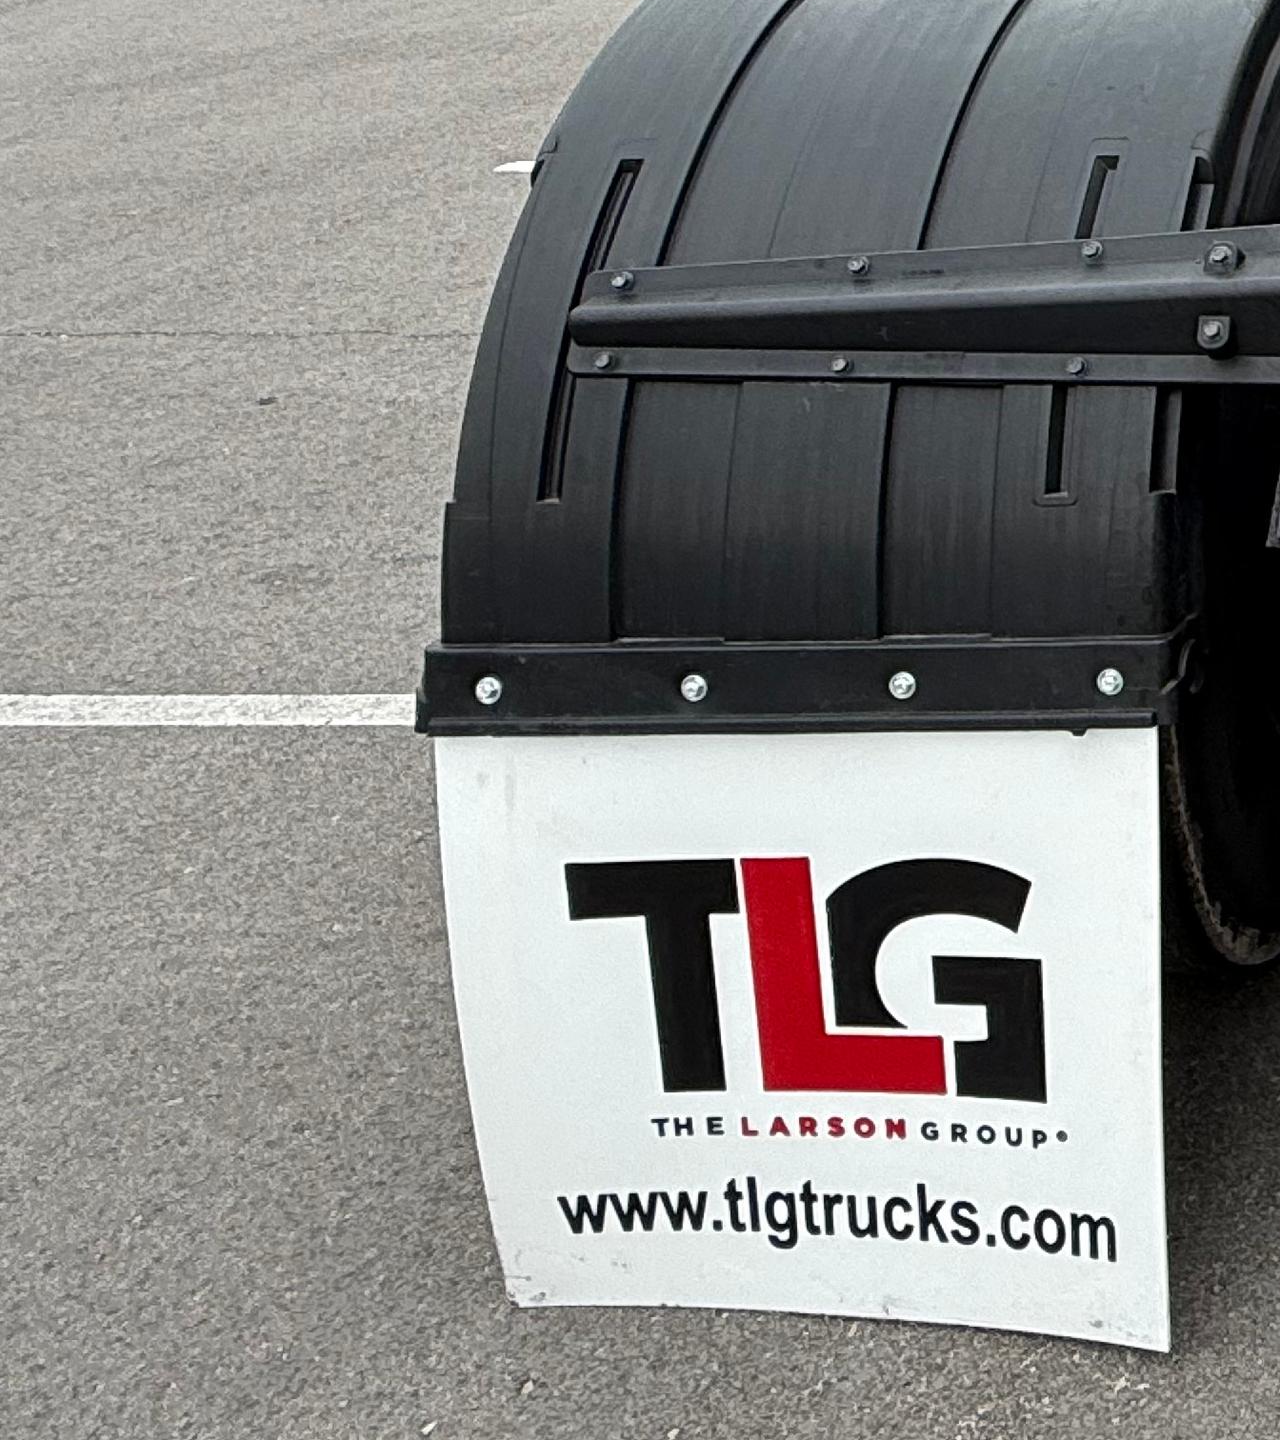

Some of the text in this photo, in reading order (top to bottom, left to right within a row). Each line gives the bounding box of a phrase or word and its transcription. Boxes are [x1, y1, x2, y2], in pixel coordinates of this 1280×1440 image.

[564, 856, 1048, 1104] TLG
[650, 1116, 725, 1137] THE
[741, 1116, 907, 1140] LARSON
[556, 1176, 1117, 1263] www.tlgtrucks.com
